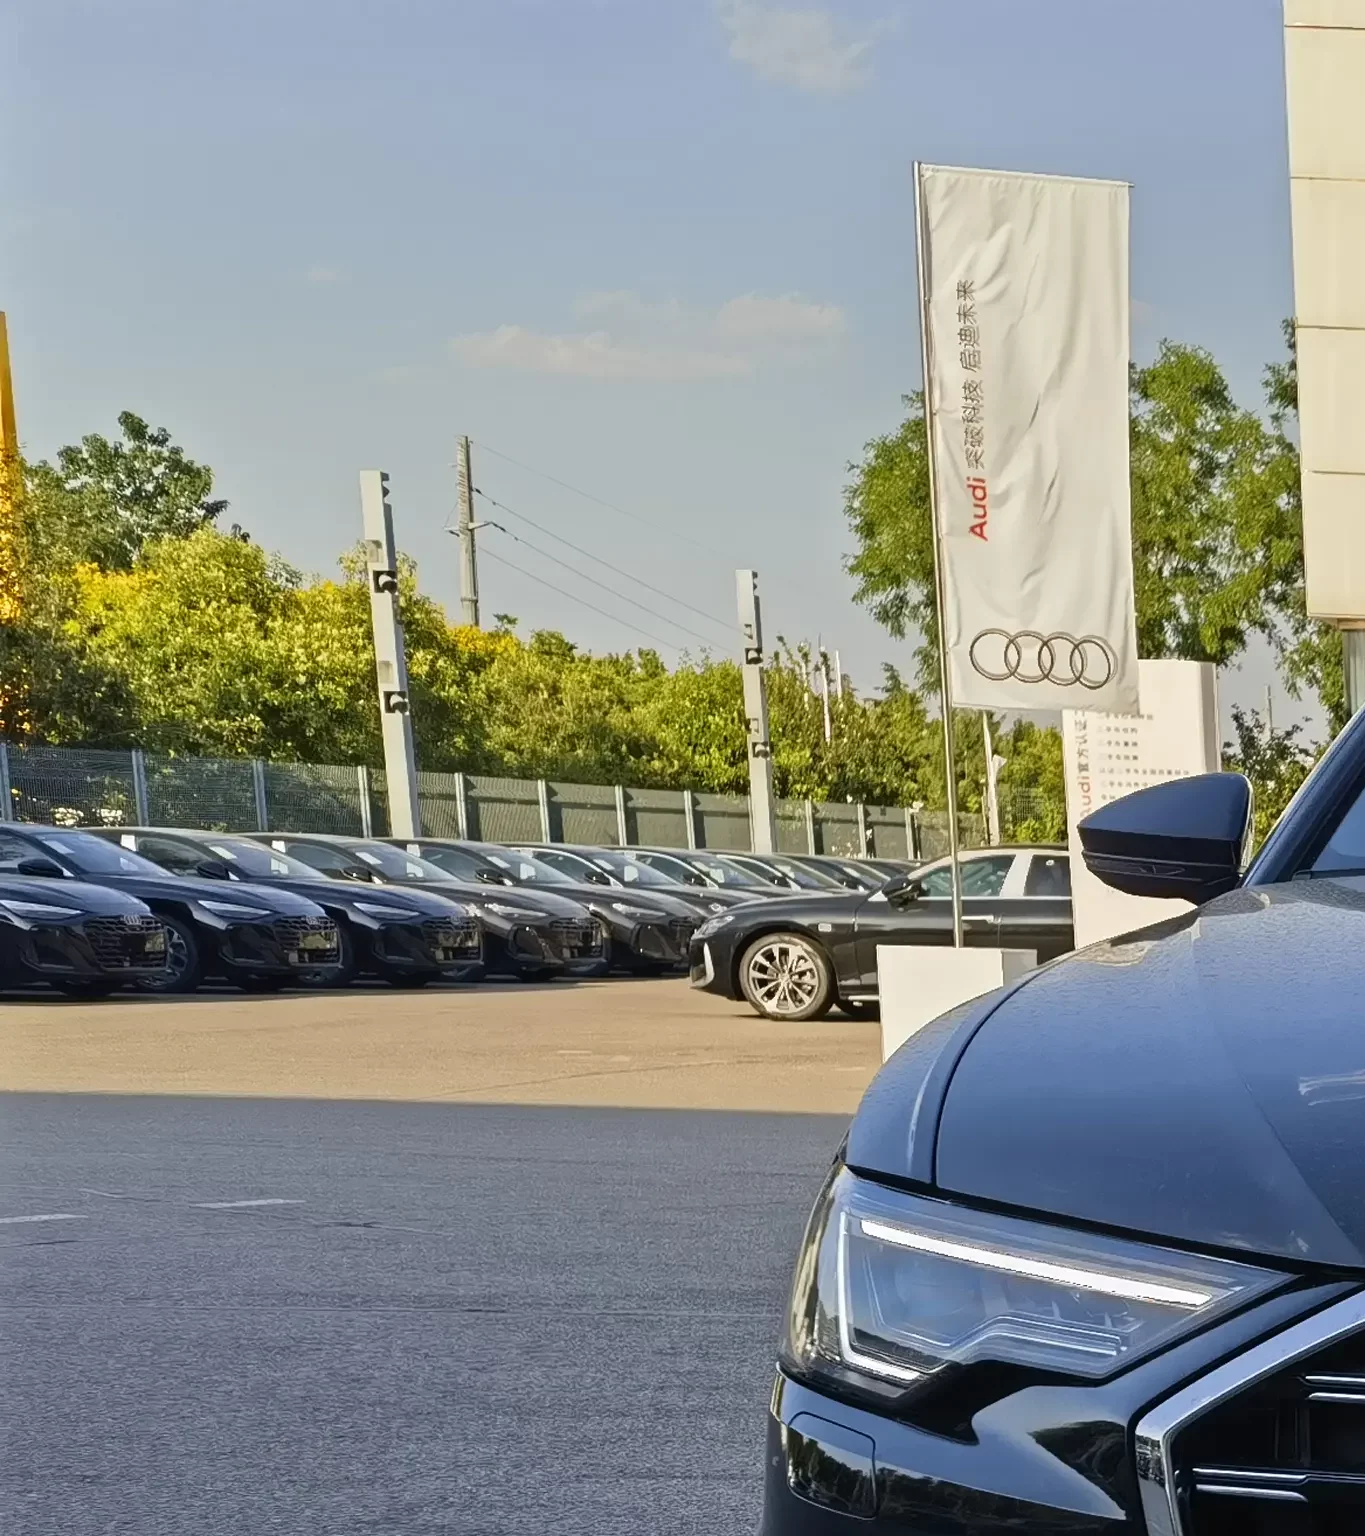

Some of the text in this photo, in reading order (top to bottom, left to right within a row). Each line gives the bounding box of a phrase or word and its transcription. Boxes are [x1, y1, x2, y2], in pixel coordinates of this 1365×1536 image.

[956, 280, 988, 541] Audi 突破科技 启迪未来
